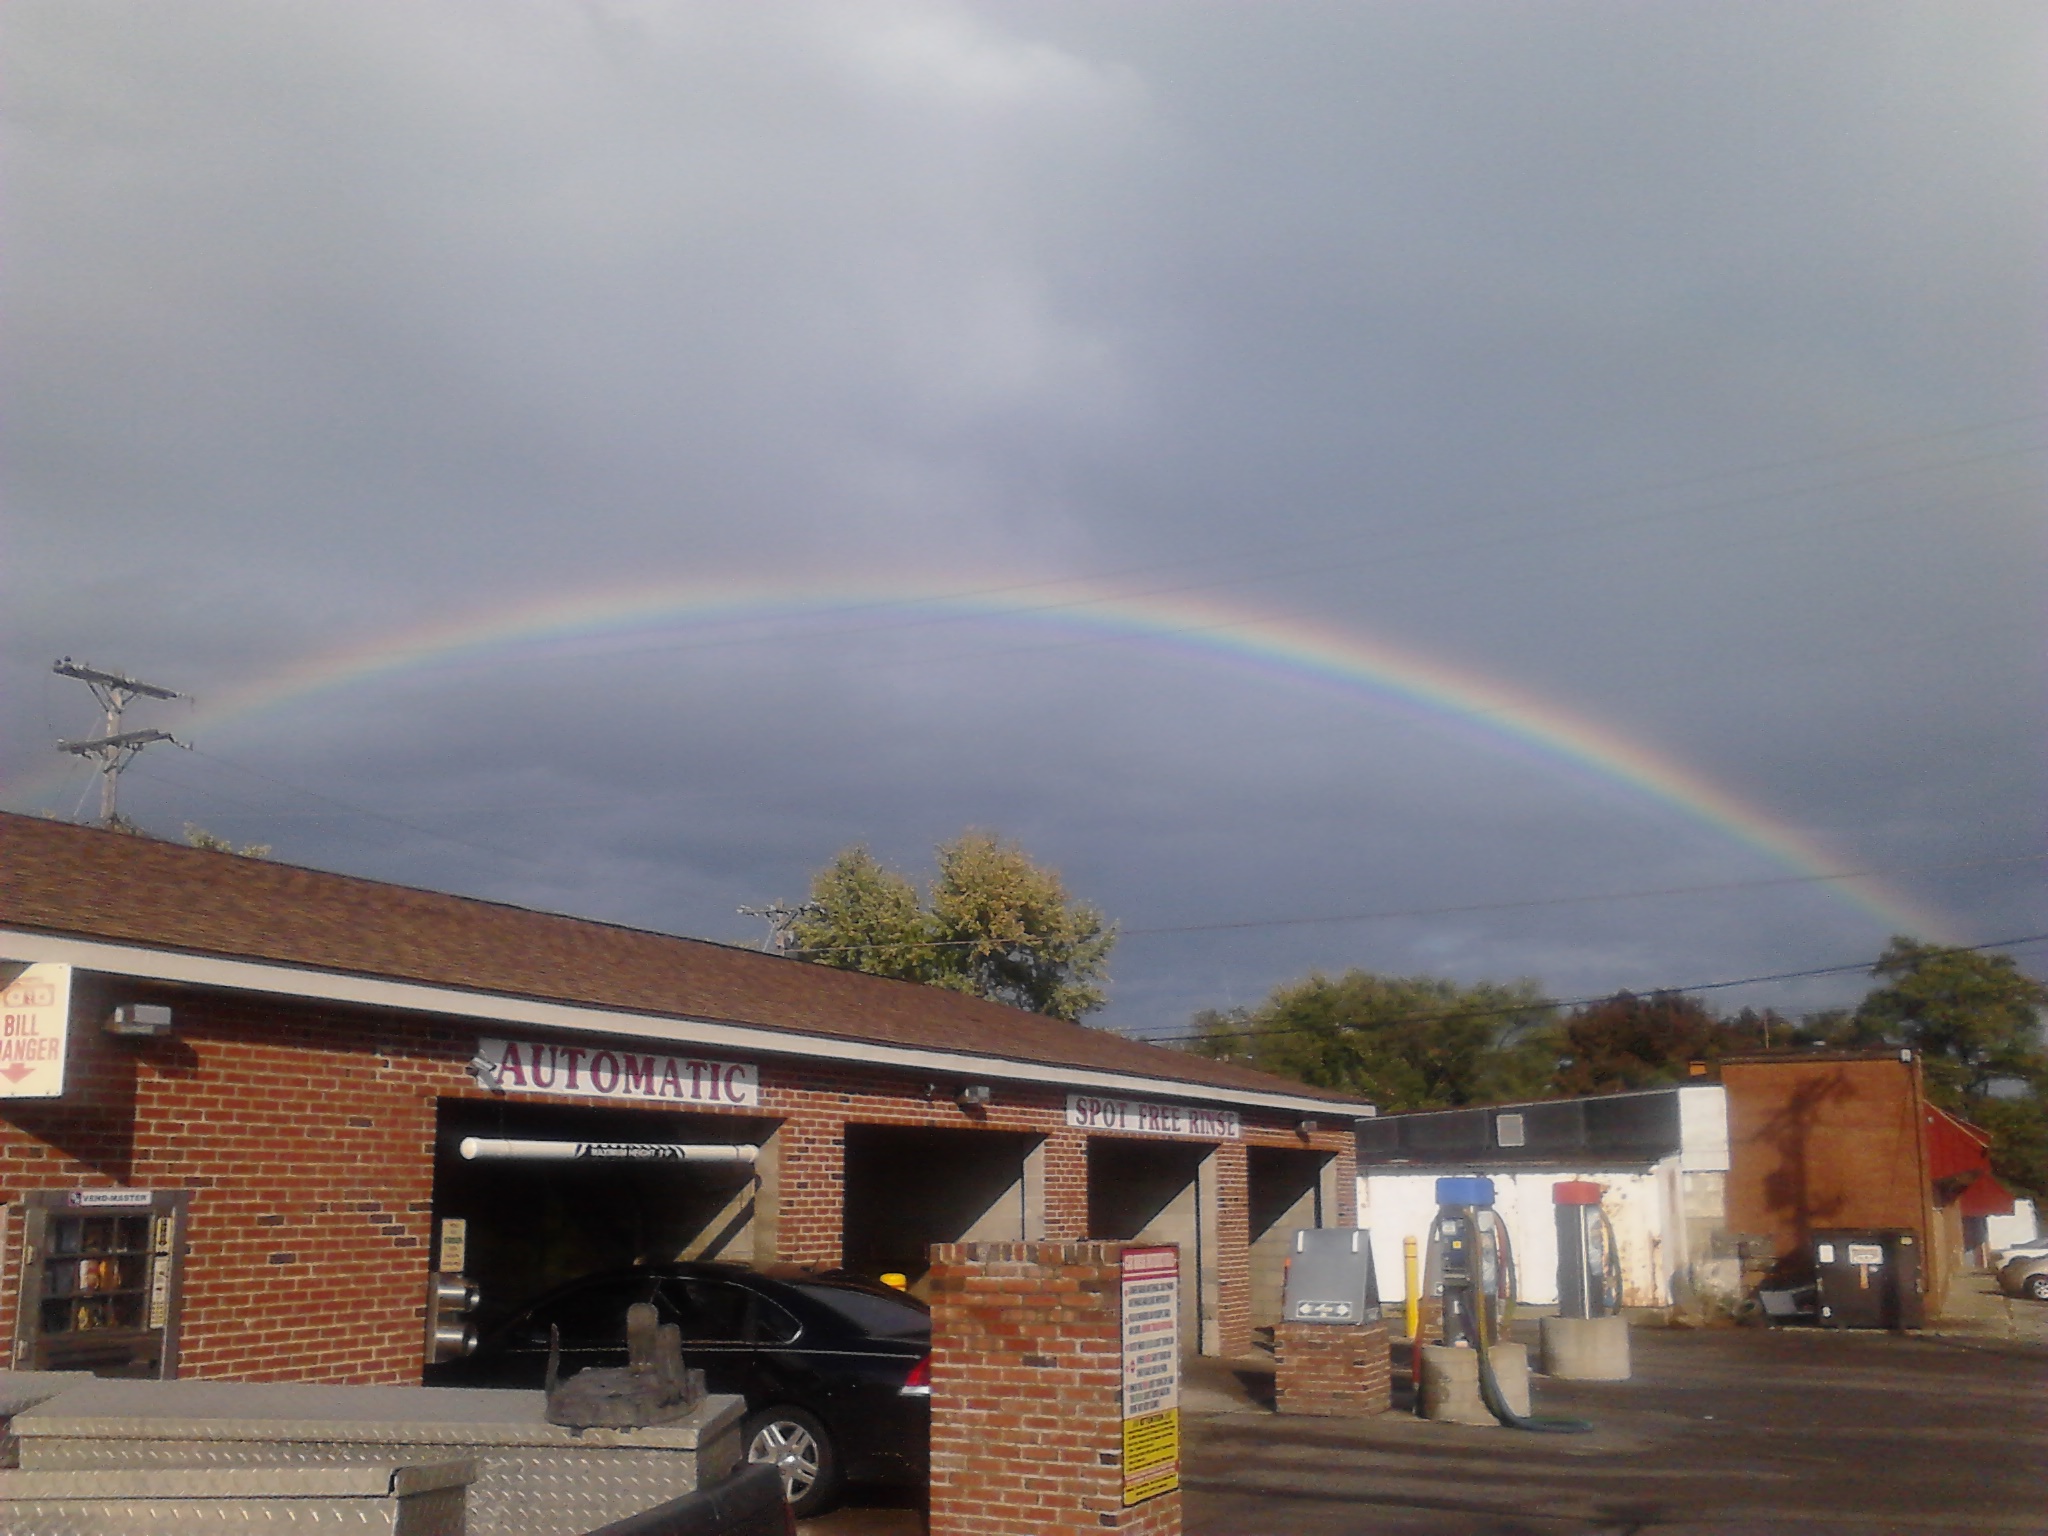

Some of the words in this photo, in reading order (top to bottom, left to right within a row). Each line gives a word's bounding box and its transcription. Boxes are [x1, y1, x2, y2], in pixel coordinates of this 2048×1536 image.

[4, 1013, 39, 1037] BILL
[0, 1037, 60, 1061] ANGER
[496, 1041, 747, 1104] AUTOMATIC
[1075, 1097, 1128, 1129] SPOT
[1138, 1103, 1182, 1132] FREE
[1187, 1109, 1236, 1137] RINSE
